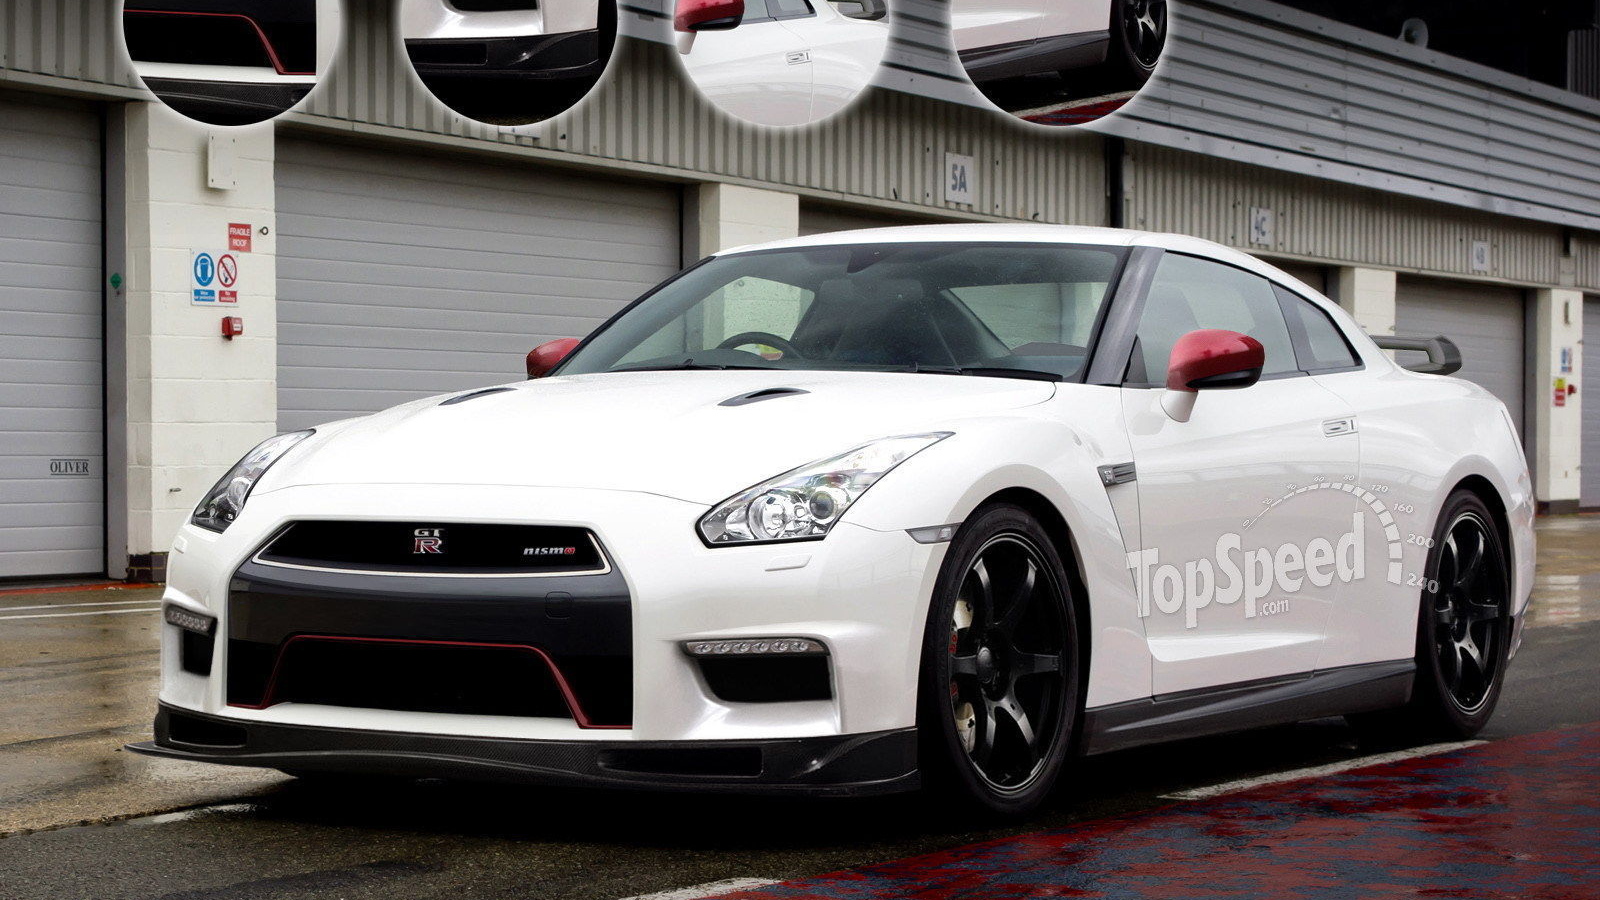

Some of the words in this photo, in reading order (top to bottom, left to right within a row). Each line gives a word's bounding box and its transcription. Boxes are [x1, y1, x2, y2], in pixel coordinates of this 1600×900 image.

[229, 227, 251, 236] FRAGILE
[232, 239, 247, 247] ROOF
[50, 461, 89, 473] OLIVER
[413, 528, 445, 537] GT
